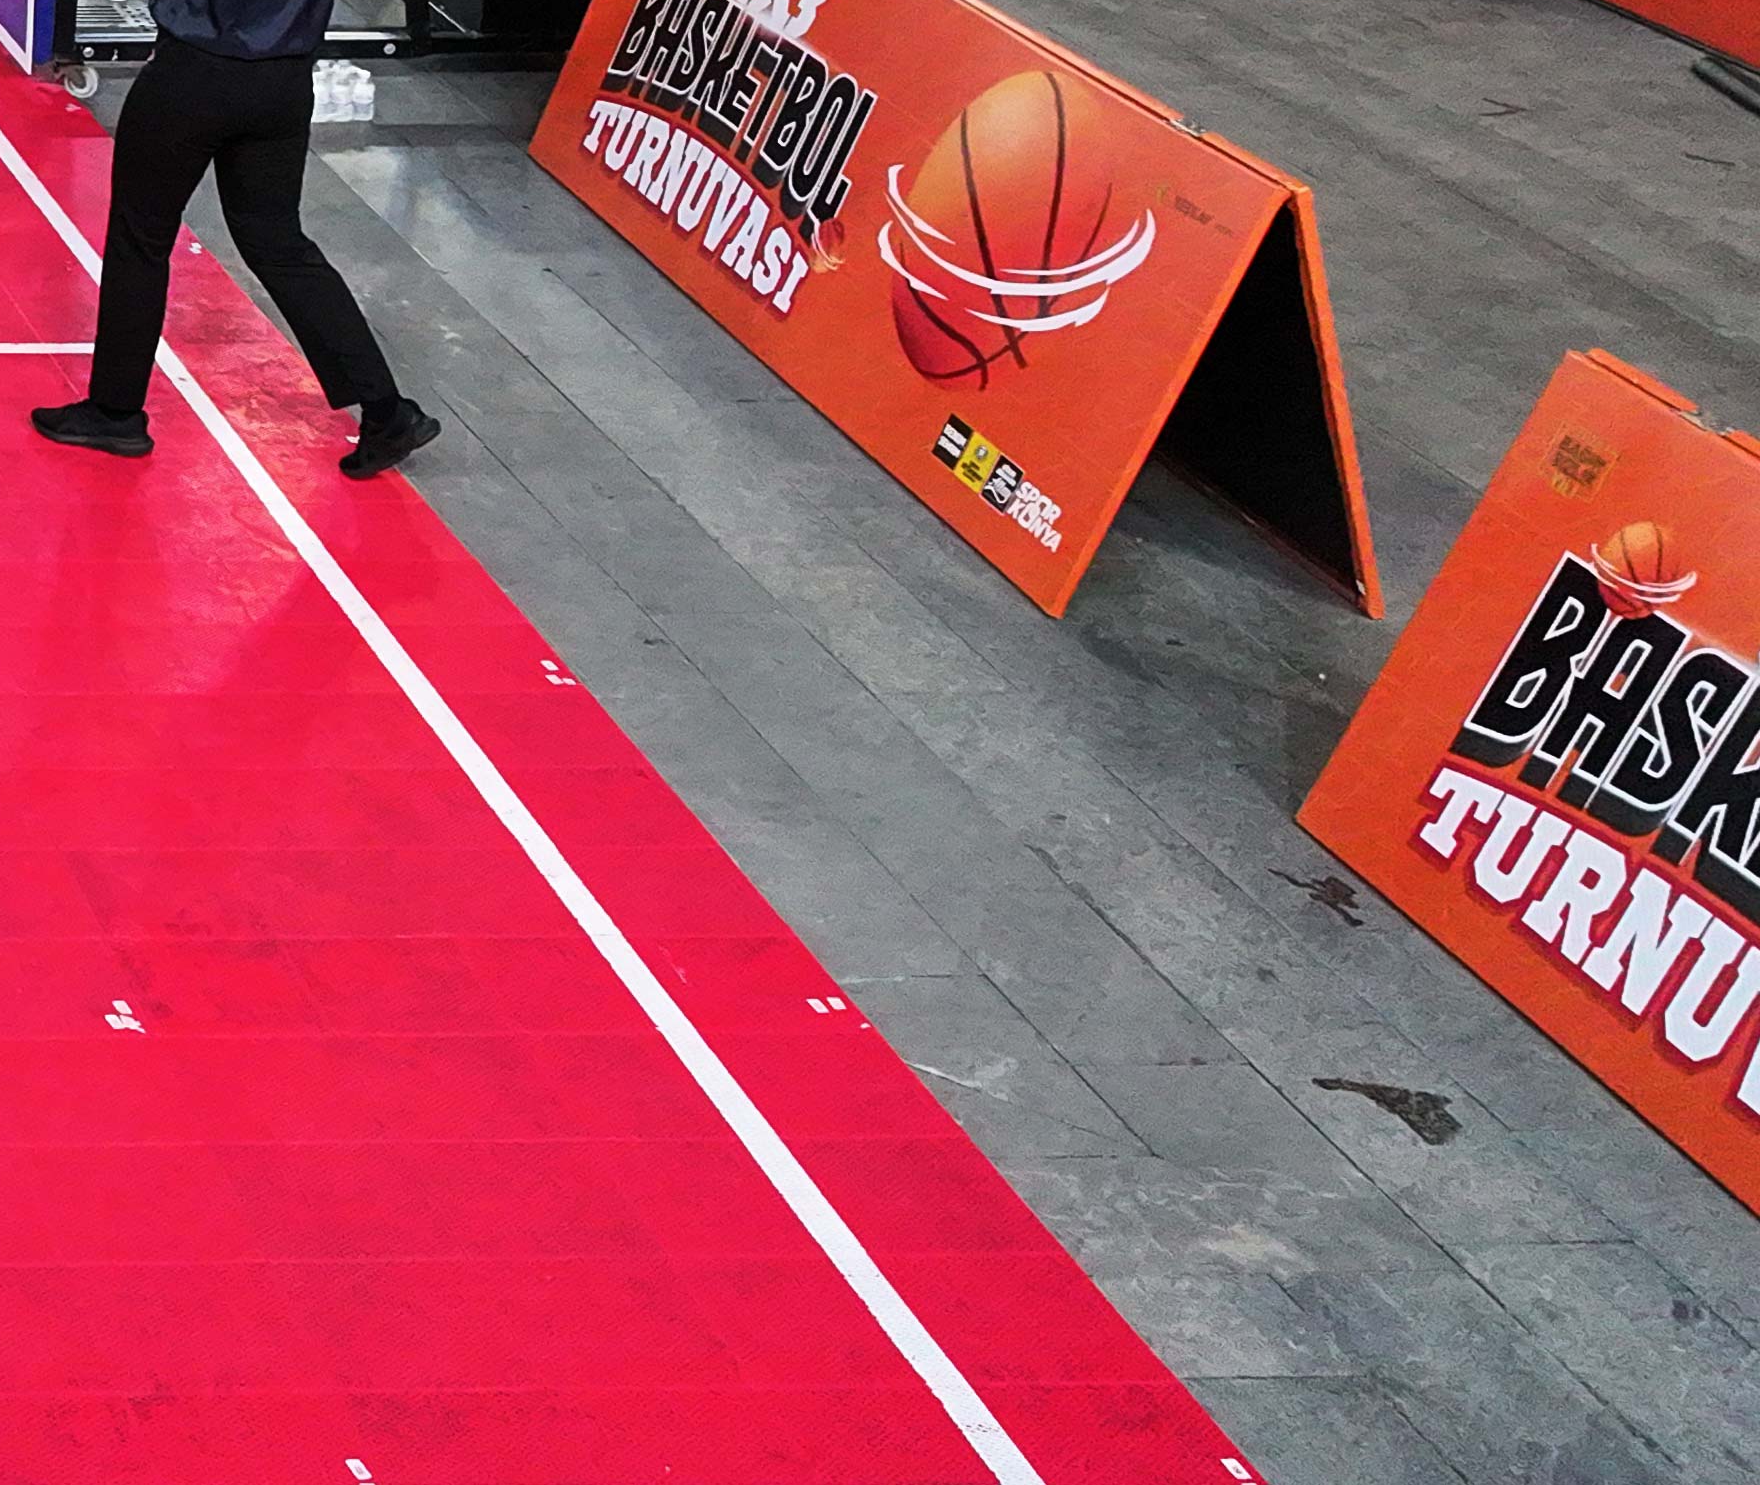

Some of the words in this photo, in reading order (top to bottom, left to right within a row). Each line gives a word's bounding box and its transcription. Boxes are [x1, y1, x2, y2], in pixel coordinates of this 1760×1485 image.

[582, 100, 809, 314] TURNUVASI
[1006, 498, 1063, 554] KONYA
[1015, 481, 1062, 525] SPOR
